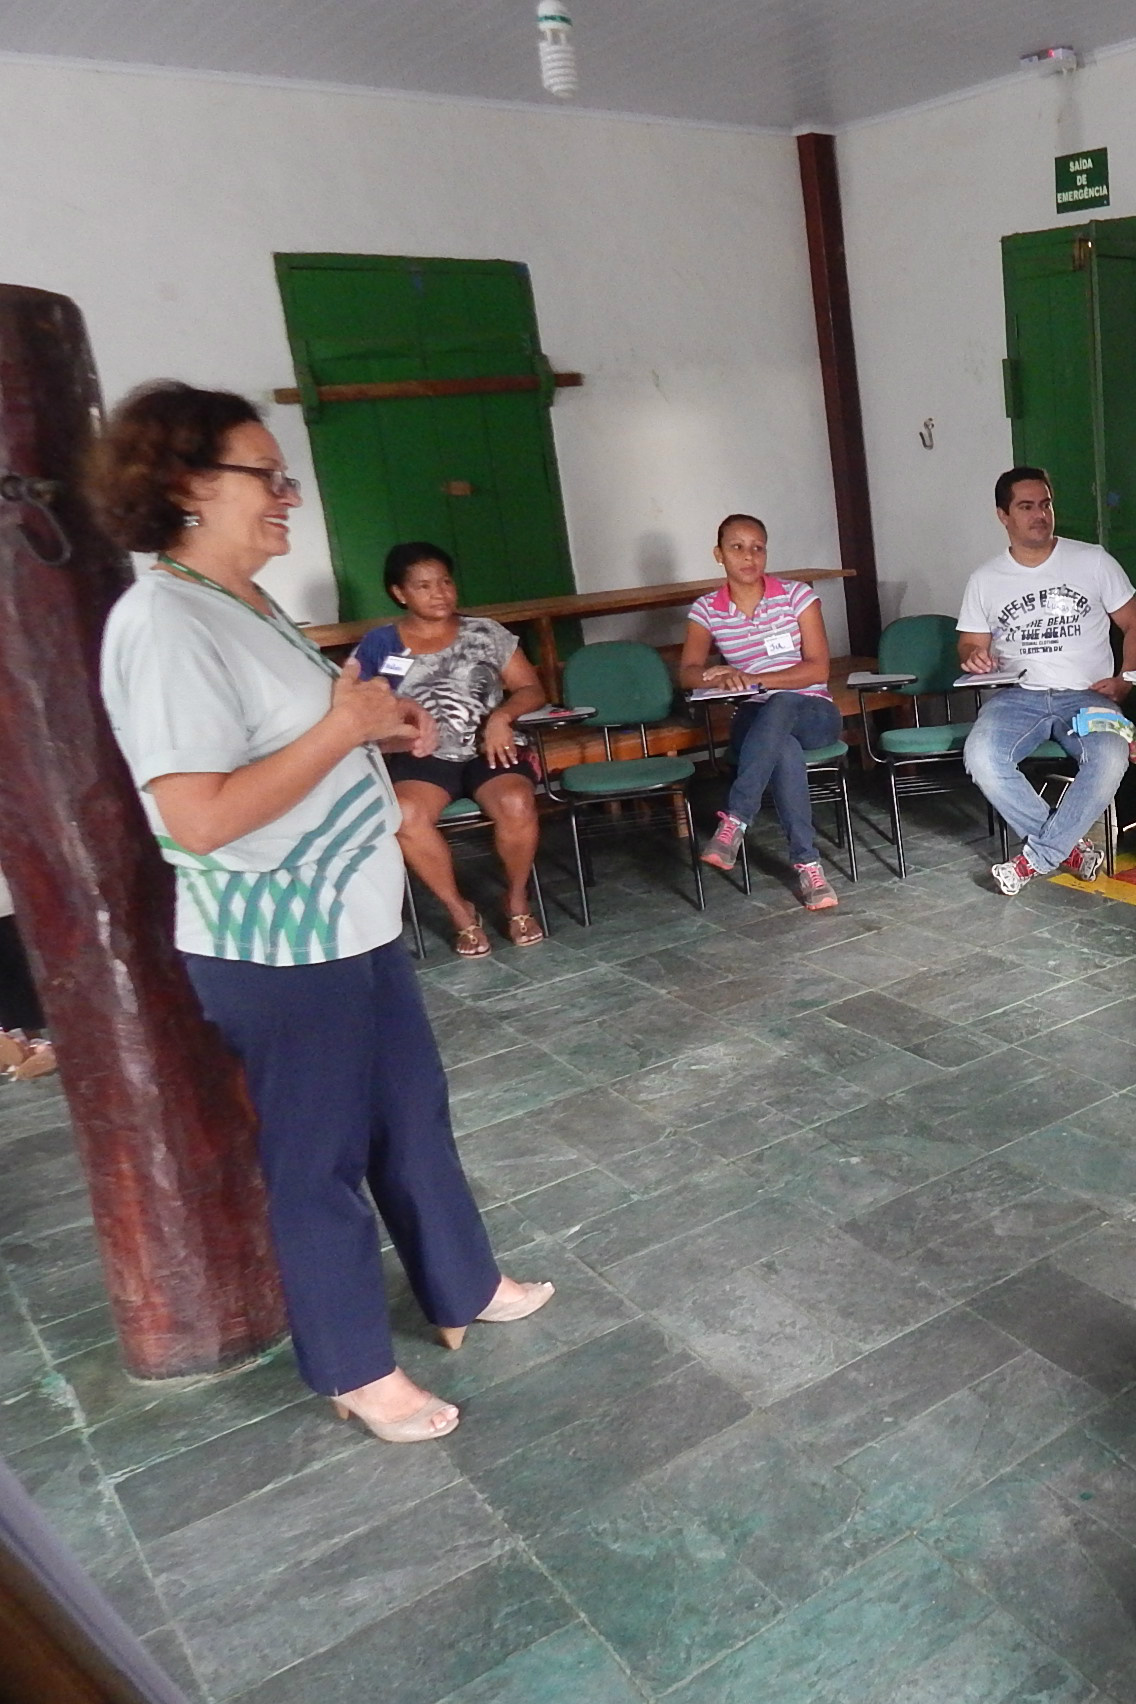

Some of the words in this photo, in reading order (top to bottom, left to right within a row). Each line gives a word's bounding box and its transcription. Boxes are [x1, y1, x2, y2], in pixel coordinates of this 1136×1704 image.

[1069, 158, 1093, 172] SAÍDA
[1076, 174, 1087, 186] DE
[1057, 185, 1108, 203] EMERGÊNCIA
